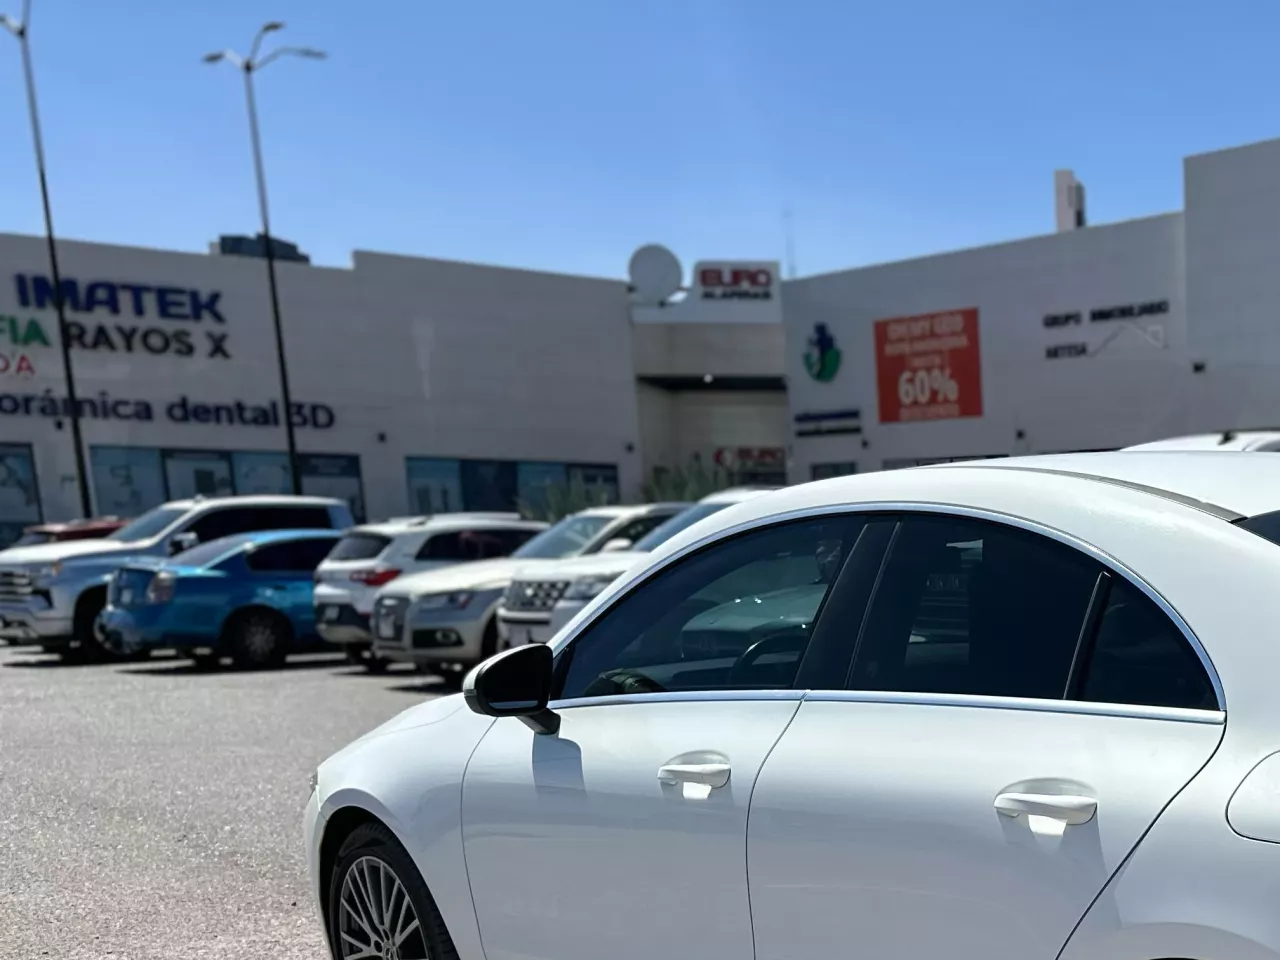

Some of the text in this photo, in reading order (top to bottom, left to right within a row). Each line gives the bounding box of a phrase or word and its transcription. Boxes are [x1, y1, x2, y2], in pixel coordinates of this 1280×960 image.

[14, 273, 225, 324] IMATEK
[63, 321, 231, 359] RAYOS X
[898, 367, 959, 405] 60%
[166, 395, 280, 427] dental
[288, 401, 335, 429] 3D
